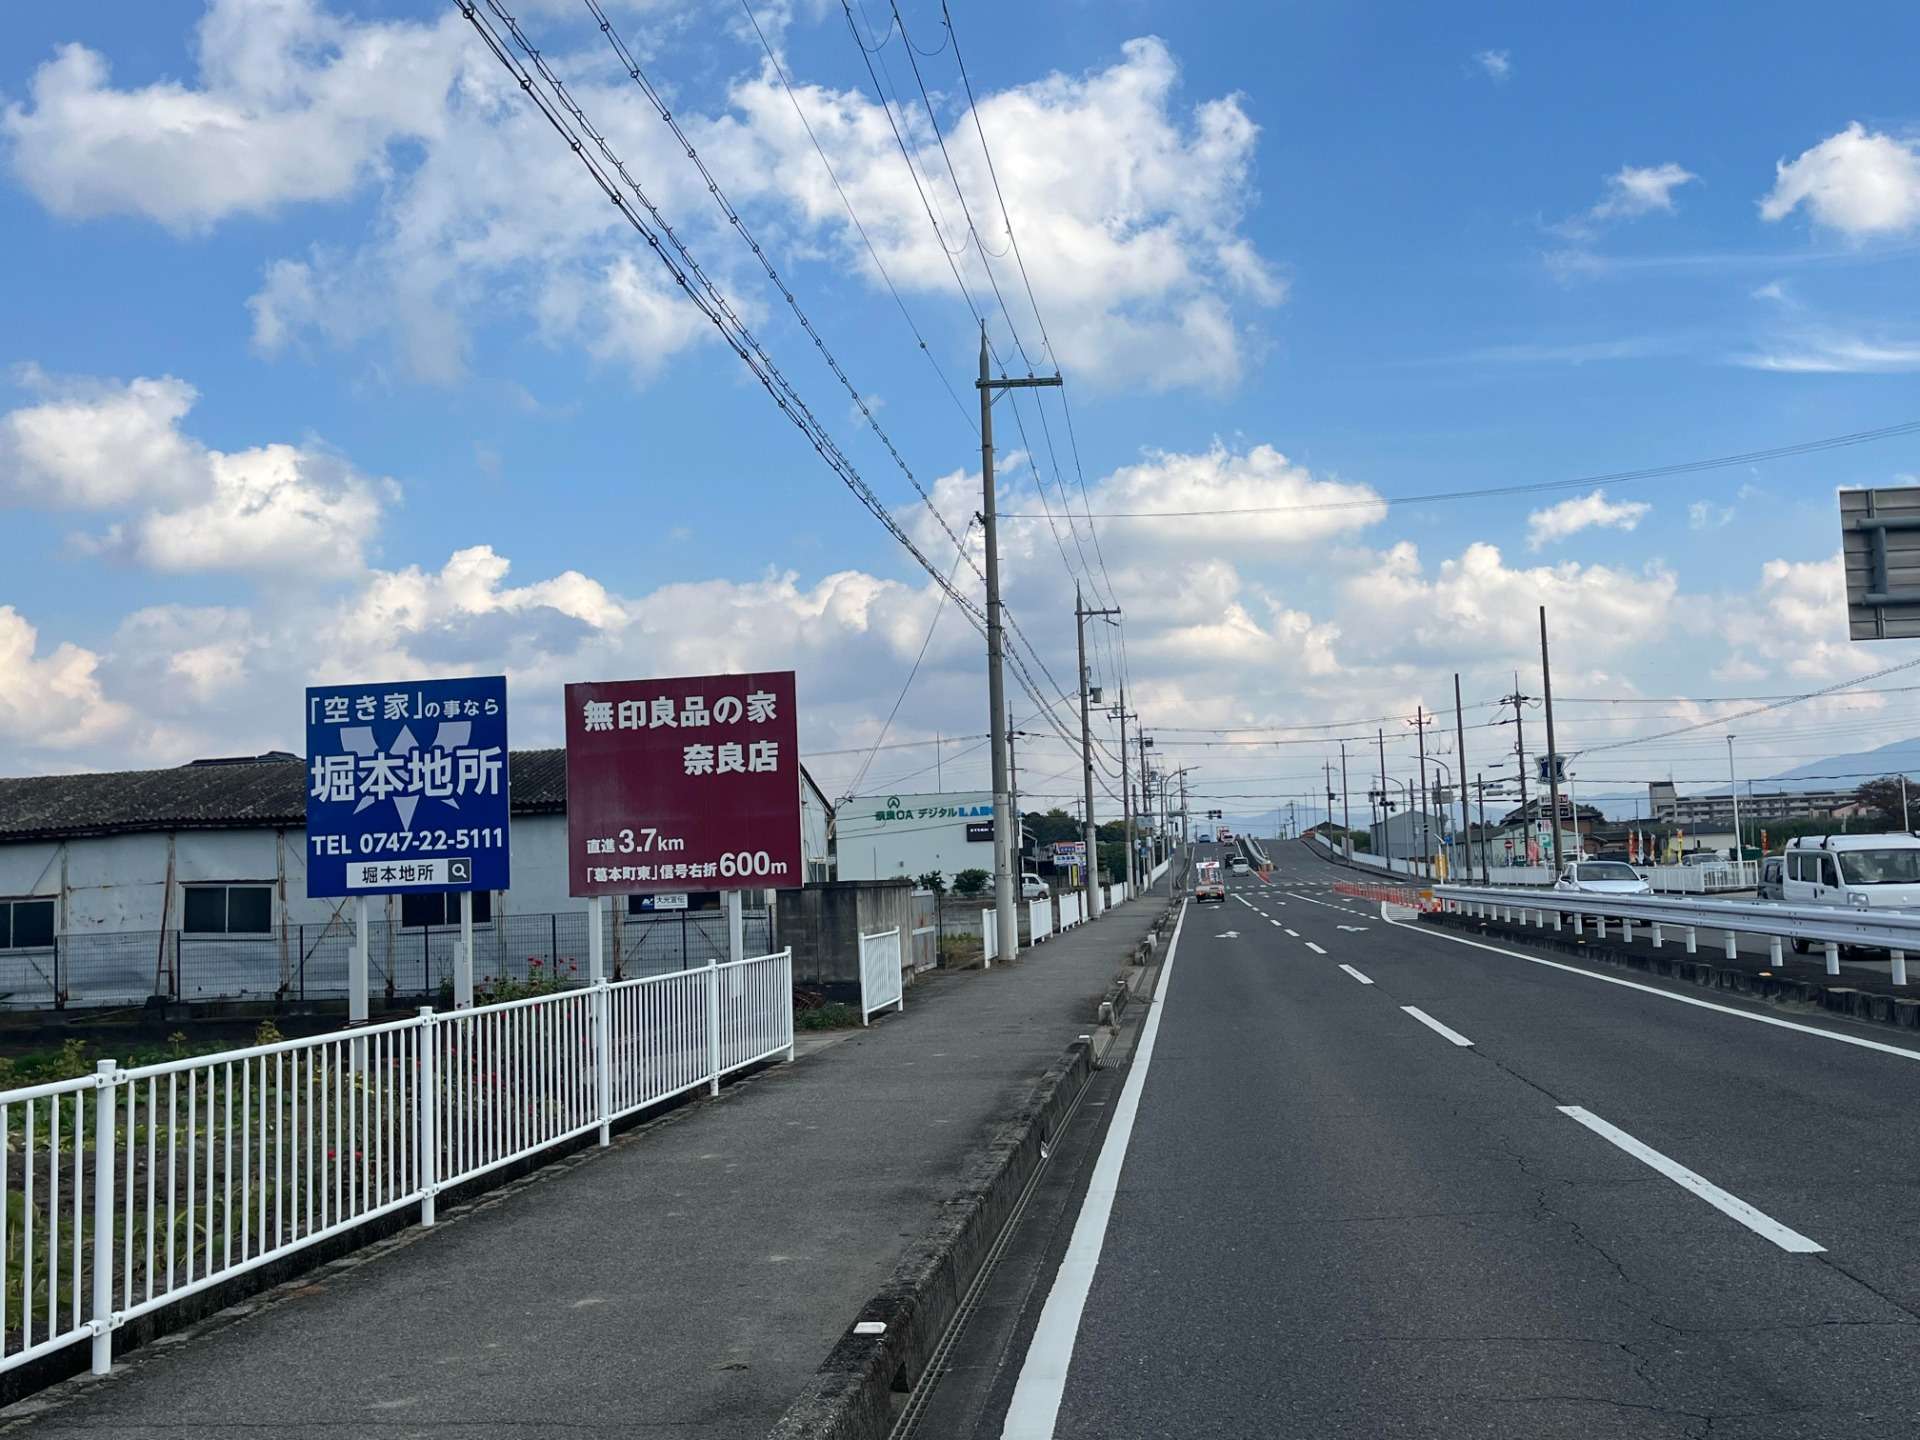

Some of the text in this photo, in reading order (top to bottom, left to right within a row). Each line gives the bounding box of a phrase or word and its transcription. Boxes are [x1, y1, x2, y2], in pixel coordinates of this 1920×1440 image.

[311, 691, 499, 725] 「空き家」の事なら
[583, 690, 777, 732] 無印良品の家
[310, 746, 502, 803] 堀本地所
[683, 740, 779, 776] 奈良店
[311, 827, 502, 856] TEL 0747-22-5111
[361, 864, 434, 884] 堀本地所
